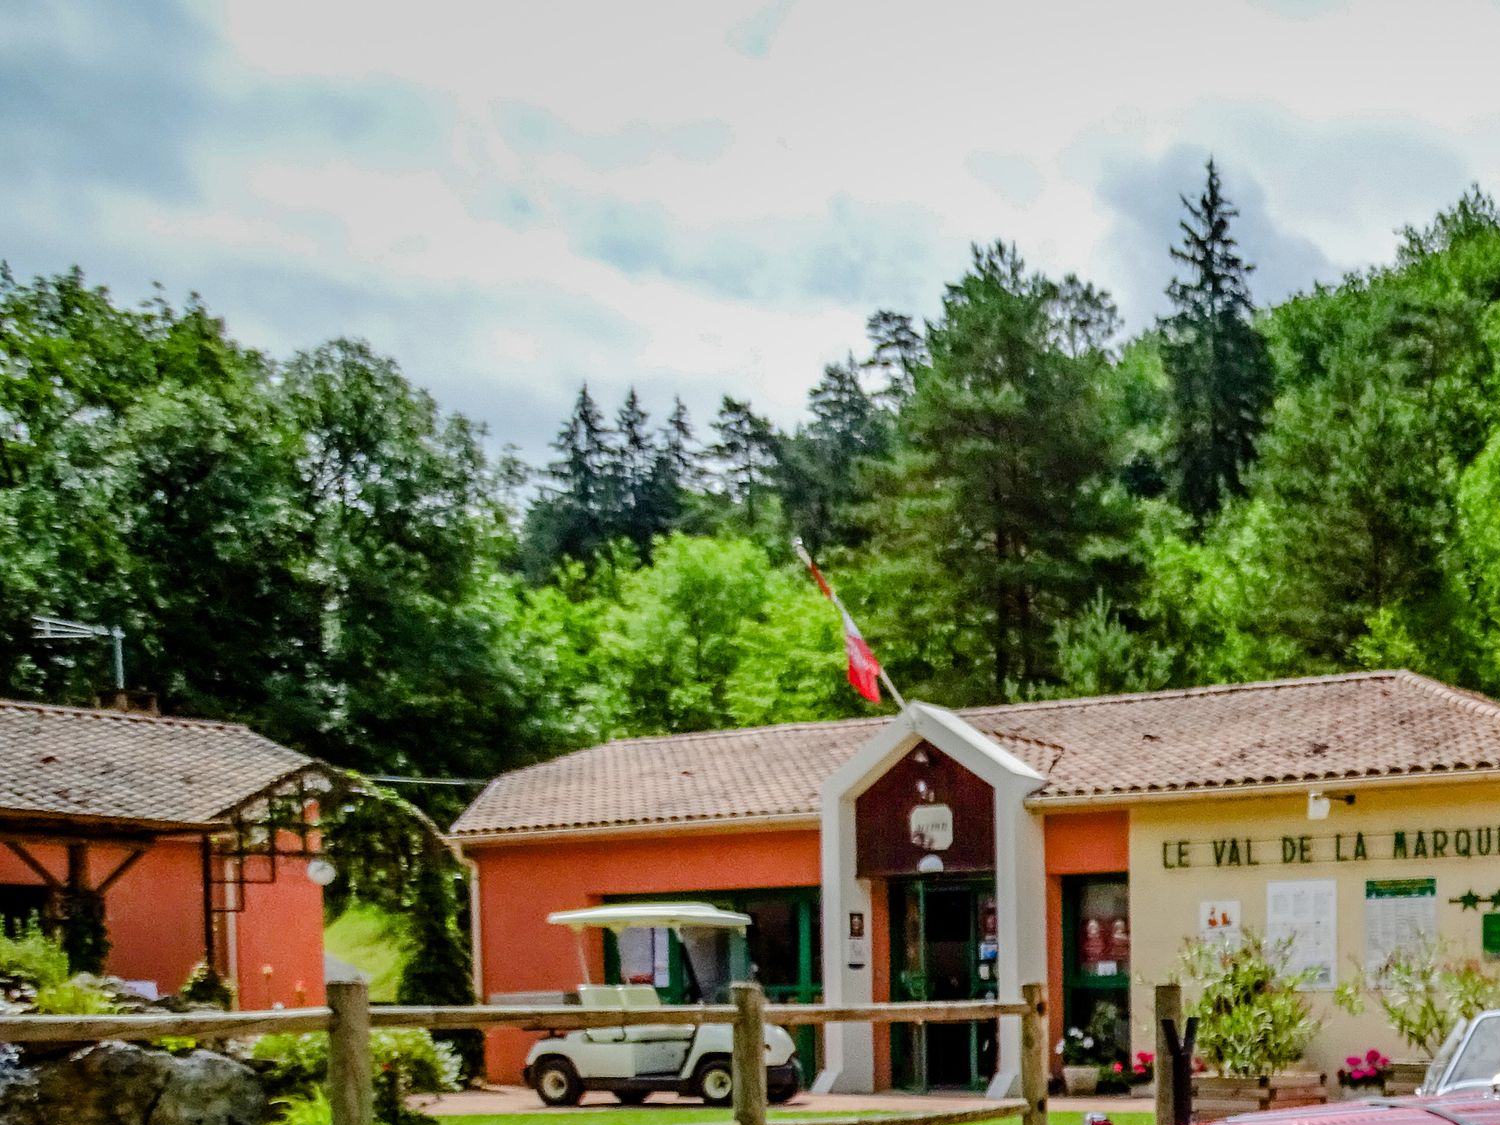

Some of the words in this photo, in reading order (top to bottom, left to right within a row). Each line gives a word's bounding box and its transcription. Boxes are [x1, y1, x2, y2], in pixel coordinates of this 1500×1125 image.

[1162, 841, 1190, 869] LE
[1213, 838, 1260, 867] VAL
[1282, 834, 1313, 864] DE
[1335, 831, 1367, 862] LA
